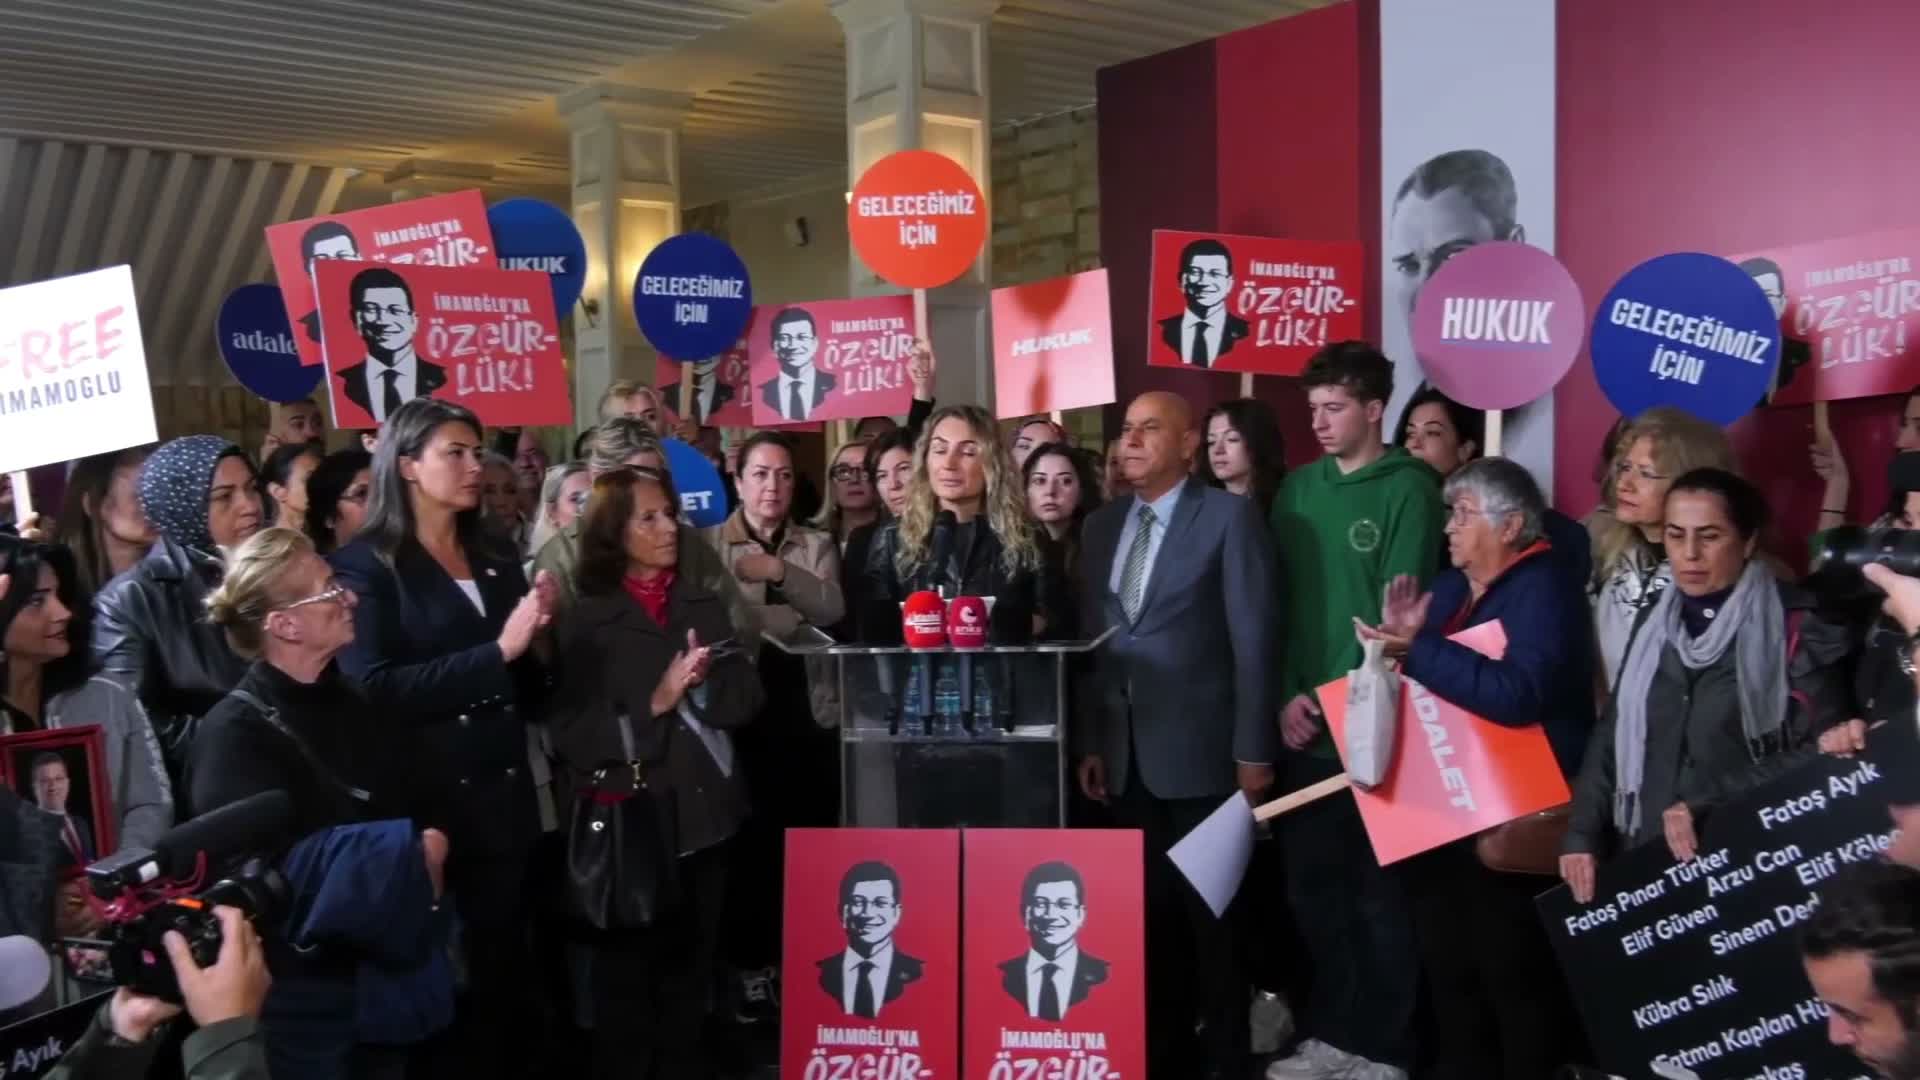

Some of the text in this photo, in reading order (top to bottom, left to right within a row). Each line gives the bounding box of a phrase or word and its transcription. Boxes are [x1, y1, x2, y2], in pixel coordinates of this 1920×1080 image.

[858, 189, 976, 217] GELECEĞİMİZ
[899, 219, 937, 249] İÇİN
[498, 256, 568, 273] UKUK
[641, 275, 744, 298] GELECEĞİMİZ
[1237, 280, 1356, 316] ÖZGÜR-
[1795, 276, 1920, 335] ÖZGÜR
[675, 301, 709, 326] İÇİN
[1256, 313, 1328, 347] LÜK!
[1441, 297, 1555, 344] HUKUK
[1610, 298, 1772, 364] GELECEĞİMİZ
[232, 330, 297, 355] adale
[426, 314, 558, 358] ÖZGÜR-
[824, 331, 913, 369] ÖZGÜR
[1821, 320, 1906, 369] LÜK!
[456, 356, 533, 396] LÜK!
[843, 363, 904, 395] LÜK!
[1649, 344, 1706, 385] İÇİN
[1758, 761, 1880, 829] Fatoş Ayık
[1706, 843, 1802, 898] Arzu Can
[1795, 851, 1837, 886] Elif
[1565, 848, 1730, 936] Fatoş Pınar Türker
[1621, 904, 1719, 956] Elif Güven
[1709, 919, 1776, 955] Sinem
[1632, 974, 1739, 1029] Kübra Sılık
[817, 1024, 920, 1047] İMAMOĞLU'NA
[1001, 1027, 1106, 1050] İMAMOĞLU'NA
[1721, 1012, 1798, 1053] Kaplan
[11, 1035, 63, 1073] Ayık
